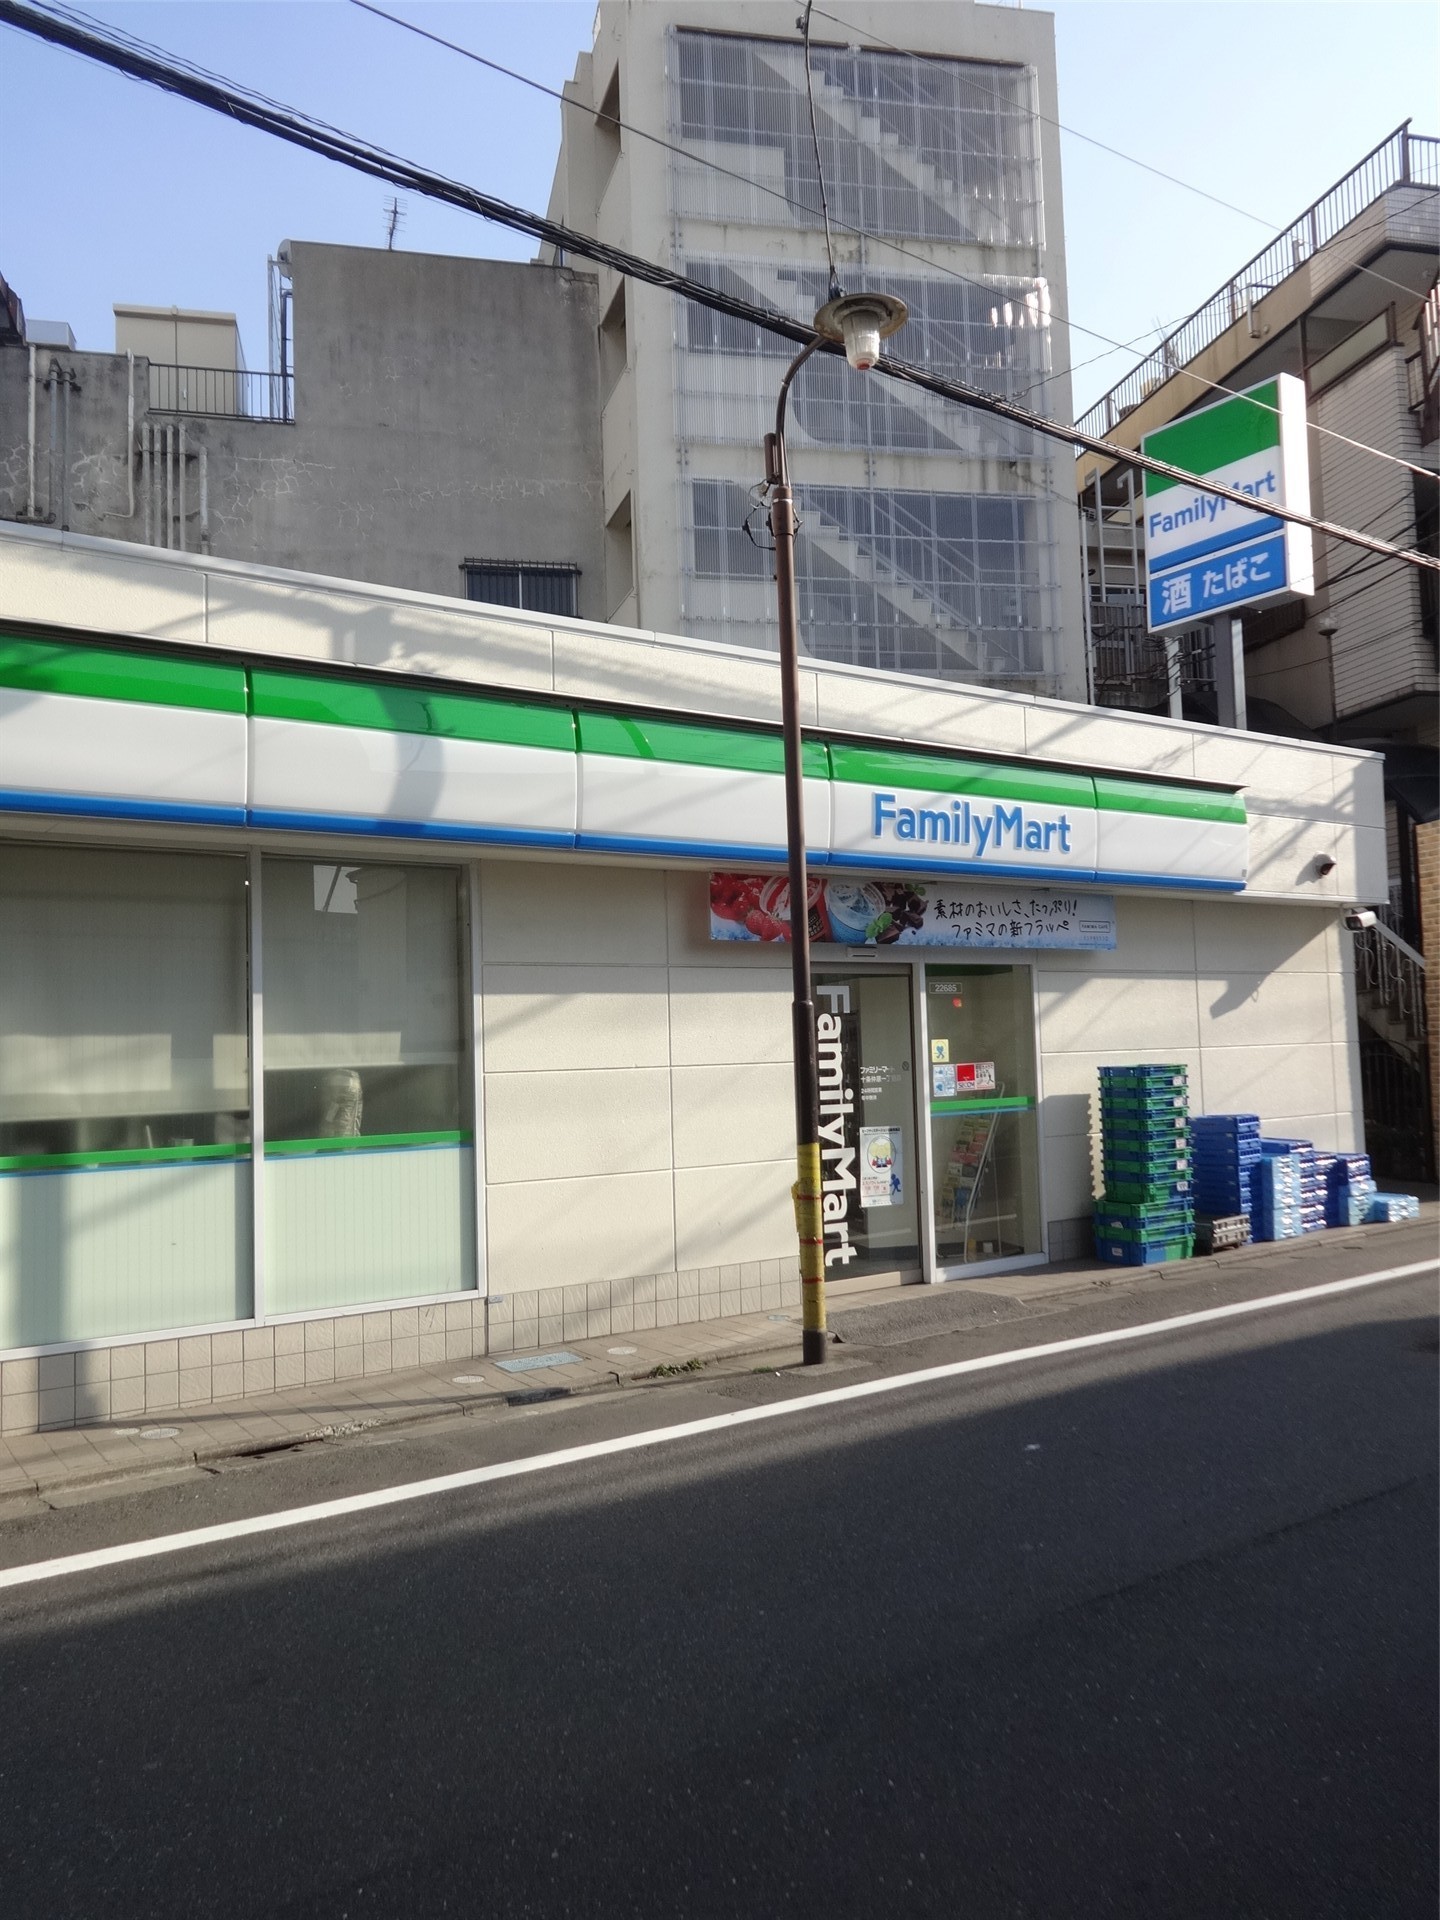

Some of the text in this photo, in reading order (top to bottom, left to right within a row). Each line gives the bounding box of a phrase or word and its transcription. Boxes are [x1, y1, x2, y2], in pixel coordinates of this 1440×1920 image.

[1161, 551, 1271, 616] 酒 たばこ
[872, 791, 1072, 857] FamilyMart
[951, 919, 1070, 940] ファミマの新フラッペ
[816, 985, 858, 1267] FamilyMart
